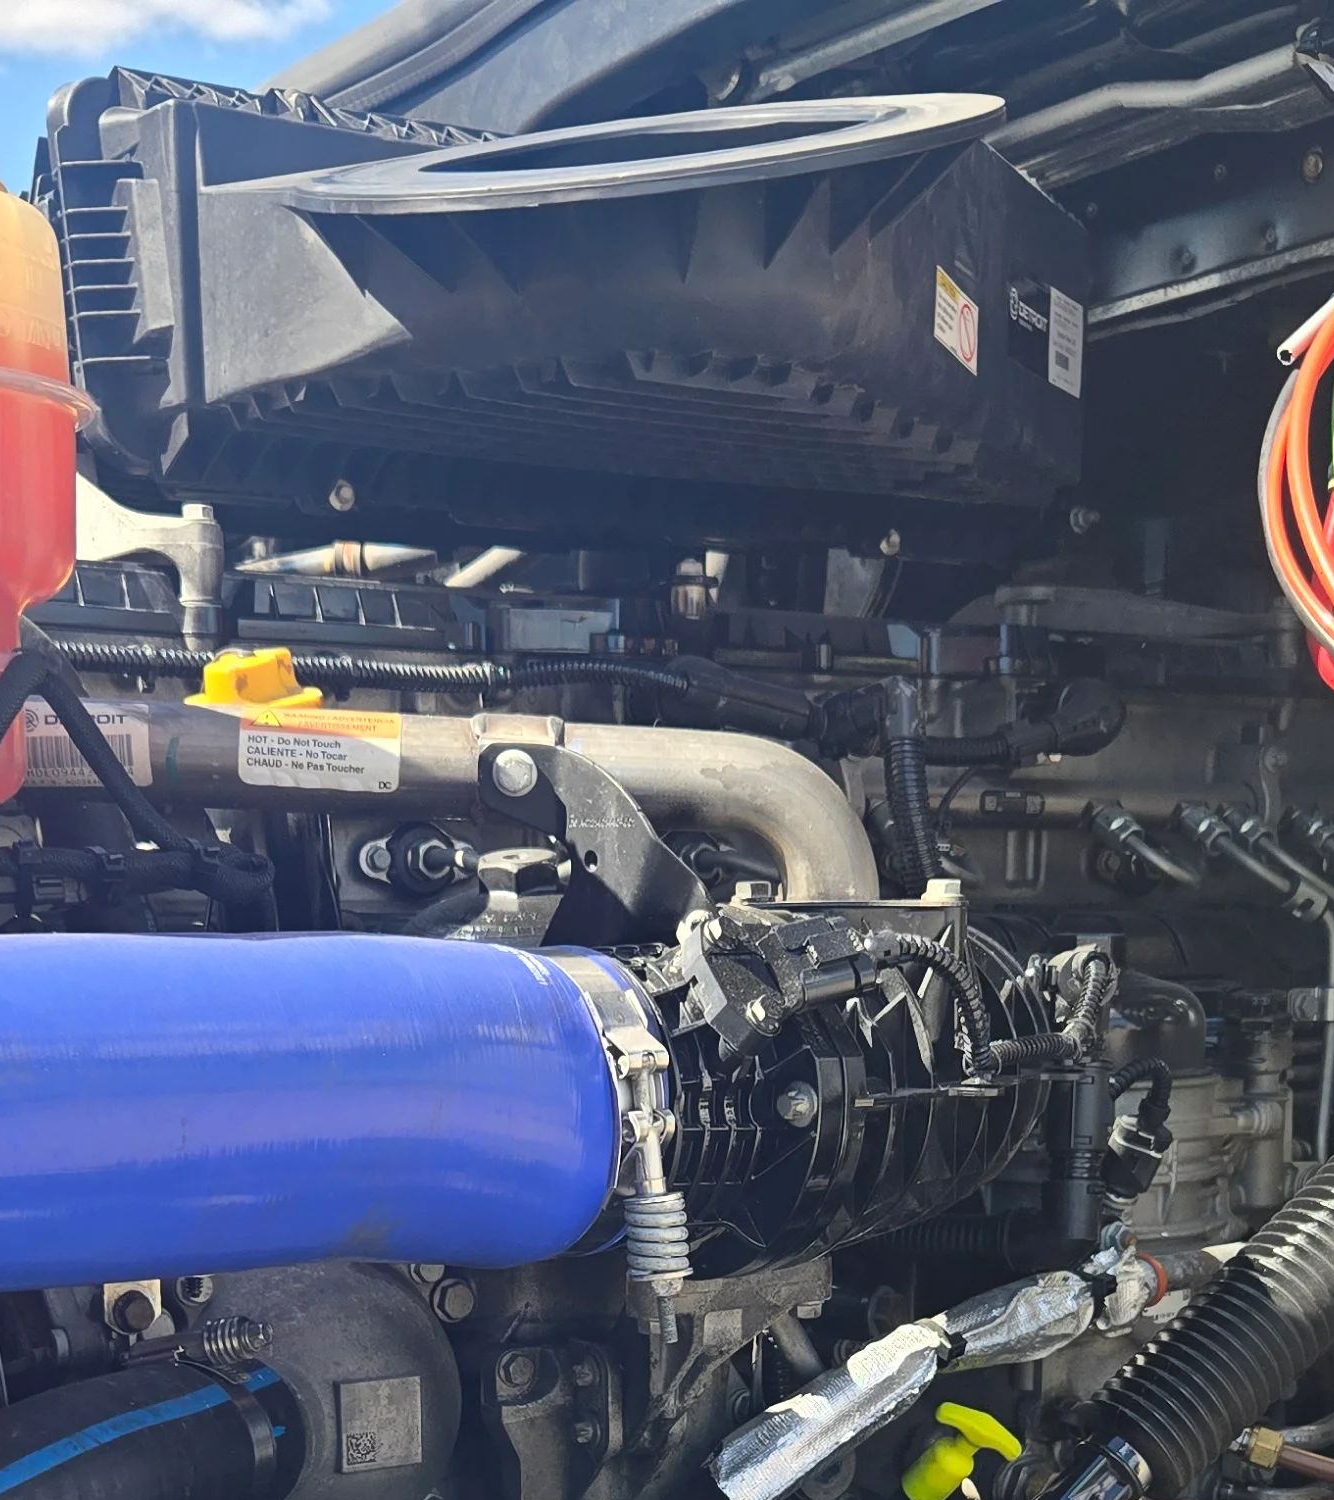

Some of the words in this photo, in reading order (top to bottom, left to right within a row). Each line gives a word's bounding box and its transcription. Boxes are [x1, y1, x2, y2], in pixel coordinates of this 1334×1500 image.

[44, 714, 128, 726] DOIT
[247, 734, 268, 745] HOT
[277, 736, 291, 746] Do
[293, 738, 310, 748] Not
[312, 739, 342, 750] Touch
[247, 746, 297, 758] CALIENTE
[305, 750, 319, 760] No
[321, 751, 348, 762] Tocar
[246, 757, 283, 768] CHAUD
[291, 761, 305, 770] Ne
[306, 762, 325, 772] Pas
[326, 763, 366, 775] Toucher
[378, 781, 393, 790] DC
